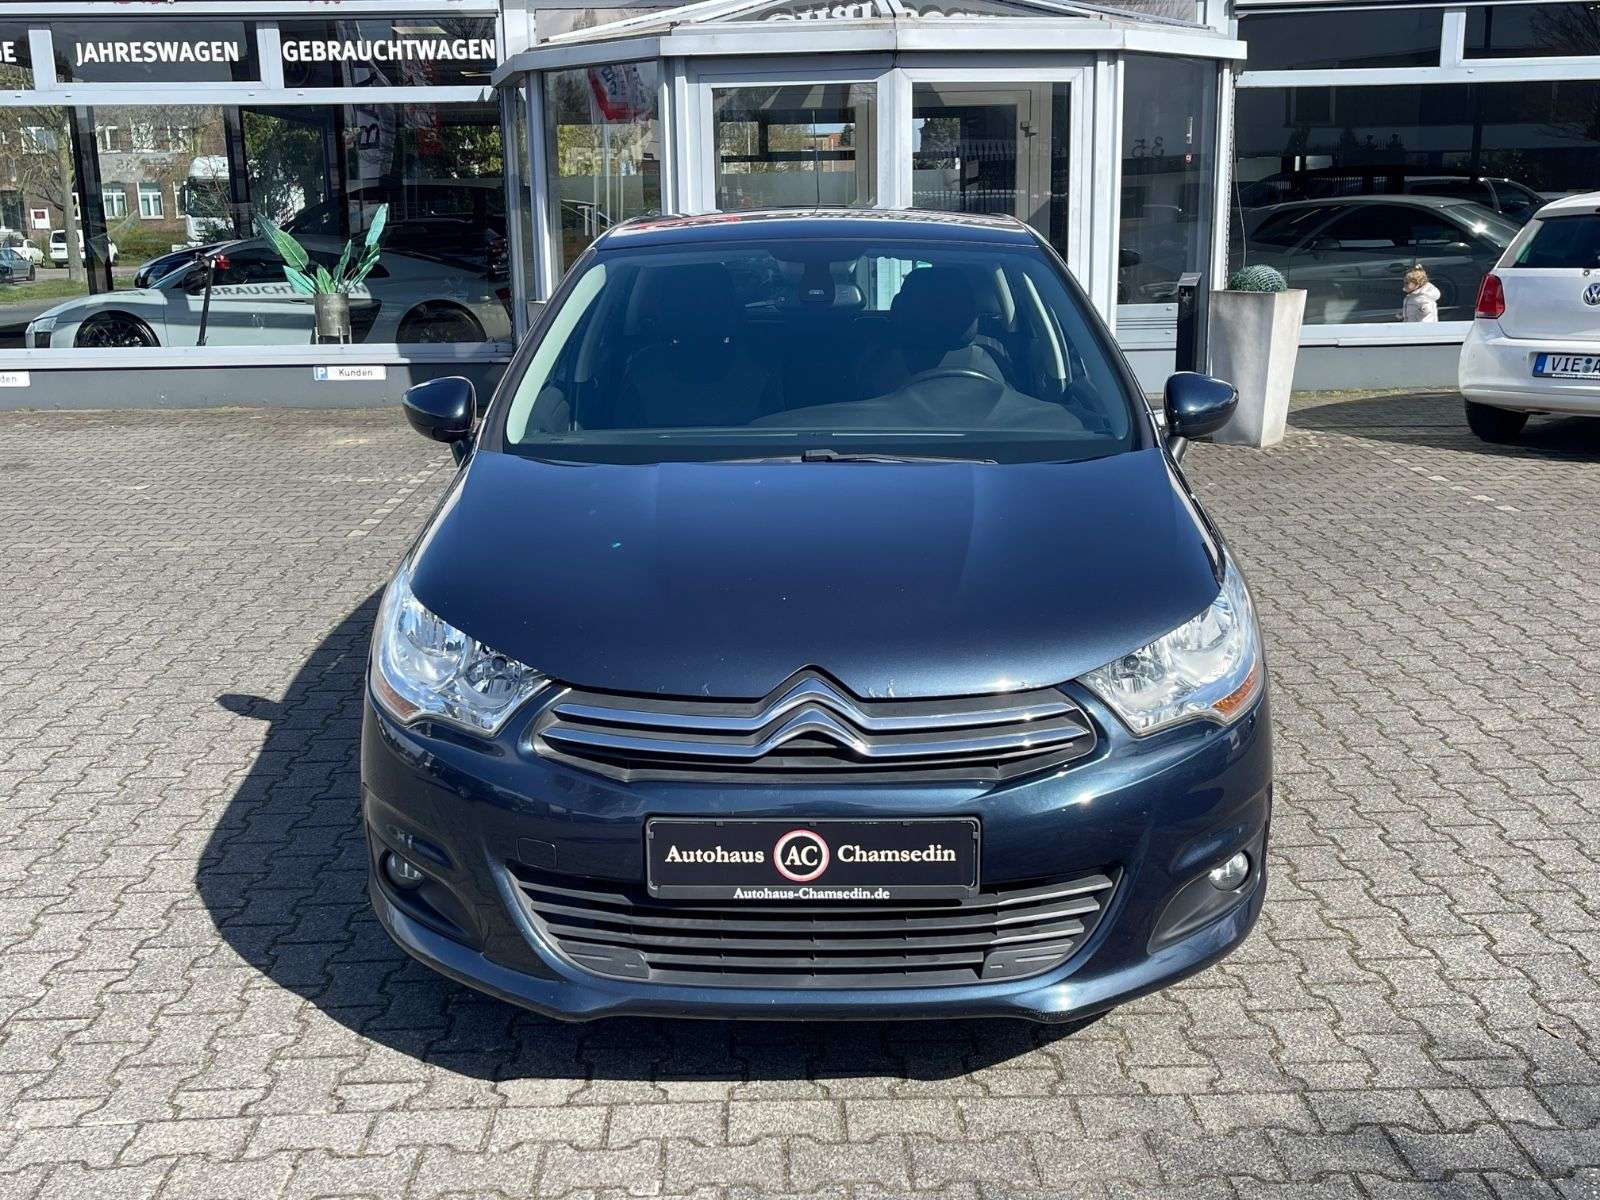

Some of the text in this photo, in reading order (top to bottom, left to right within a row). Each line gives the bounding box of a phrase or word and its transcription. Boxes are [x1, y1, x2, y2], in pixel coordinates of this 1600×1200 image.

[75, 40, 239, 67] JAHRESWAGEN
[282, 38, 495, 63] GEBRAUCHTWAGEN
[1552, 356, 1582, 372] VIE
[0, 375, 17, 384] den
[338, 368, 373, 377] Kunden
[665, 843, 957, 867] Autohaus AC Chamsedin
[733, 887, 890, 900] Autohaus-Chamsedin.de
